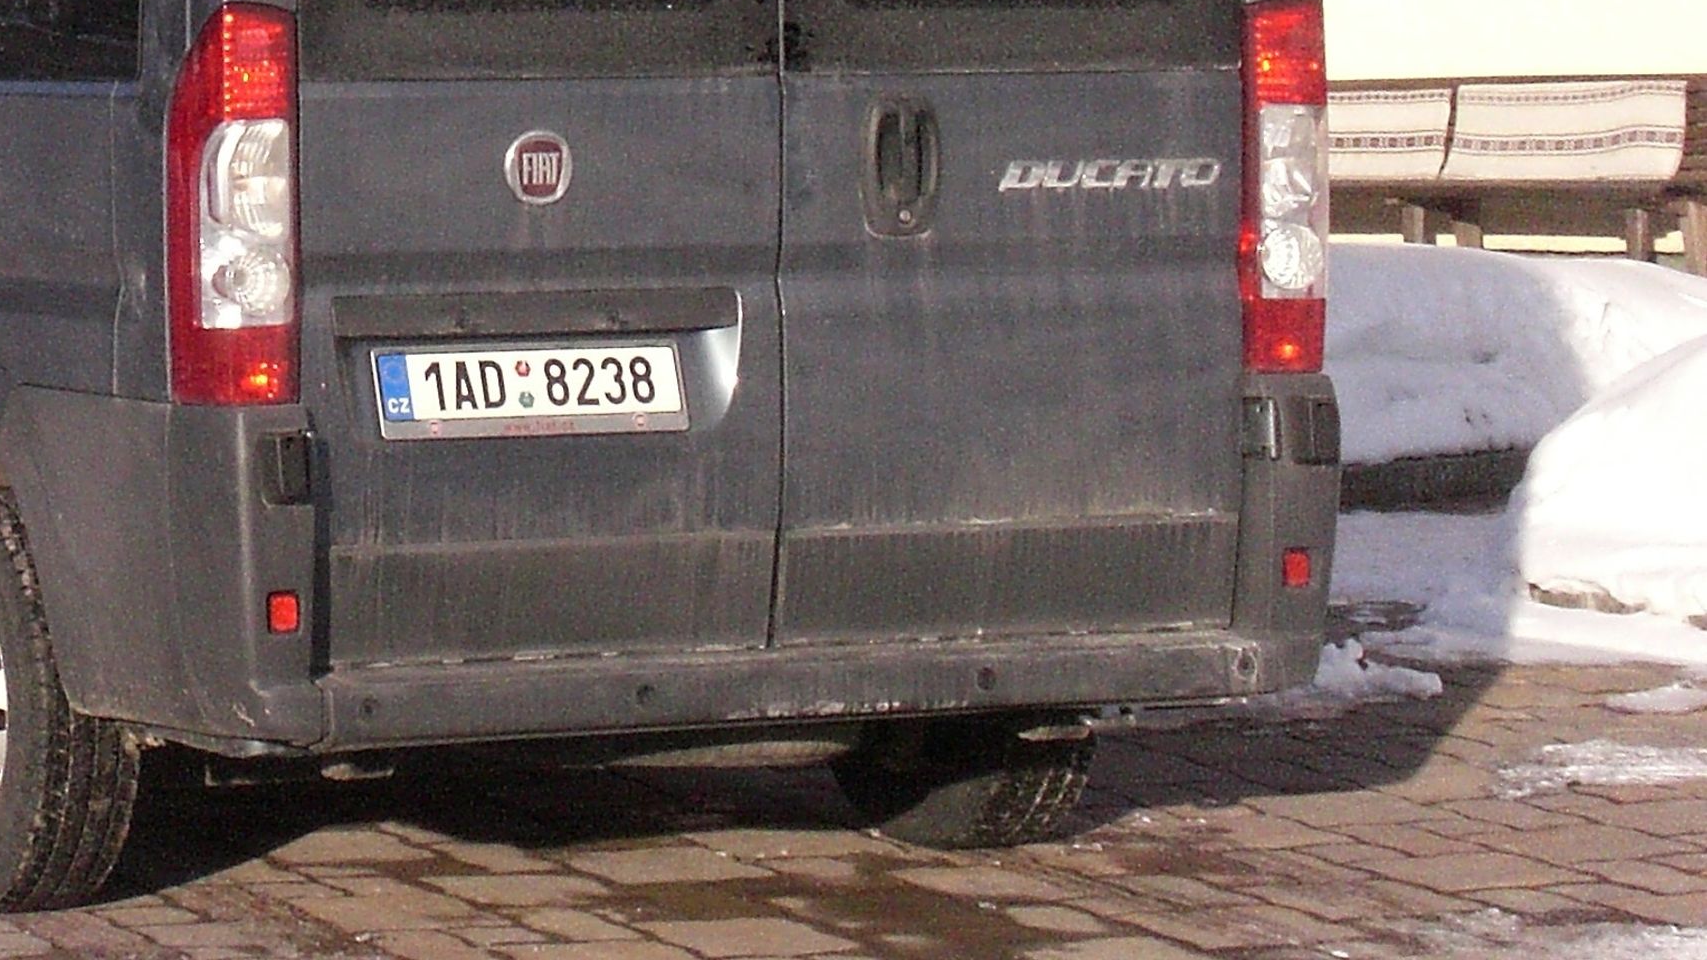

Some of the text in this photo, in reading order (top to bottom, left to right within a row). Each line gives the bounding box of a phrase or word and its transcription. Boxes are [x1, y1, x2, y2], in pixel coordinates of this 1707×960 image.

[522, 151, 560, 185] FIAT
[998, 157, 1221, 191] DUCATO
[424, 356, 656, 411] 1AD 8238
[388, 397, 411, 414] CZ
